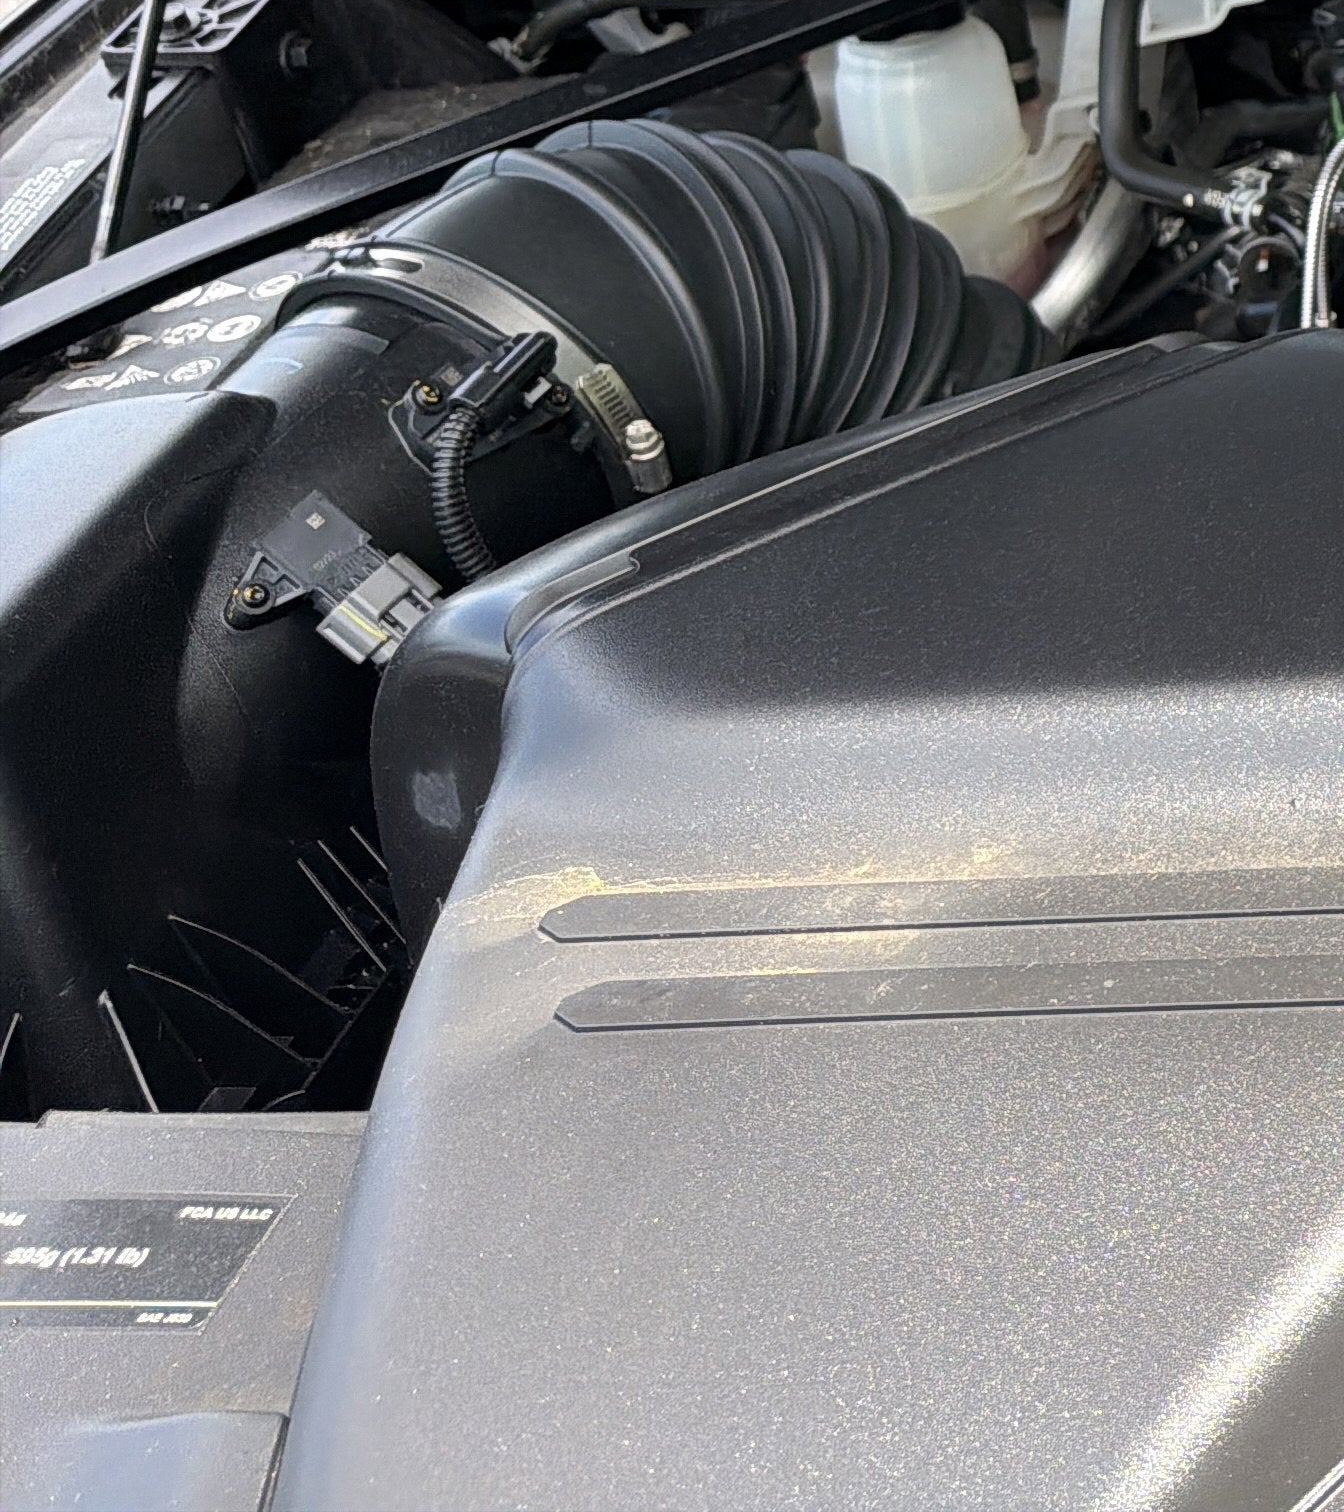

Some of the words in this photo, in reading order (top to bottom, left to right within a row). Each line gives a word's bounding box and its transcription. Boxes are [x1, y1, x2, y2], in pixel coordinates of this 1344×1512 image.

[179, 1206, 214, 1219] FCA
[239, 1207, 274, 1221] LLC
[58, 1246, 118, 1269] (1.31
